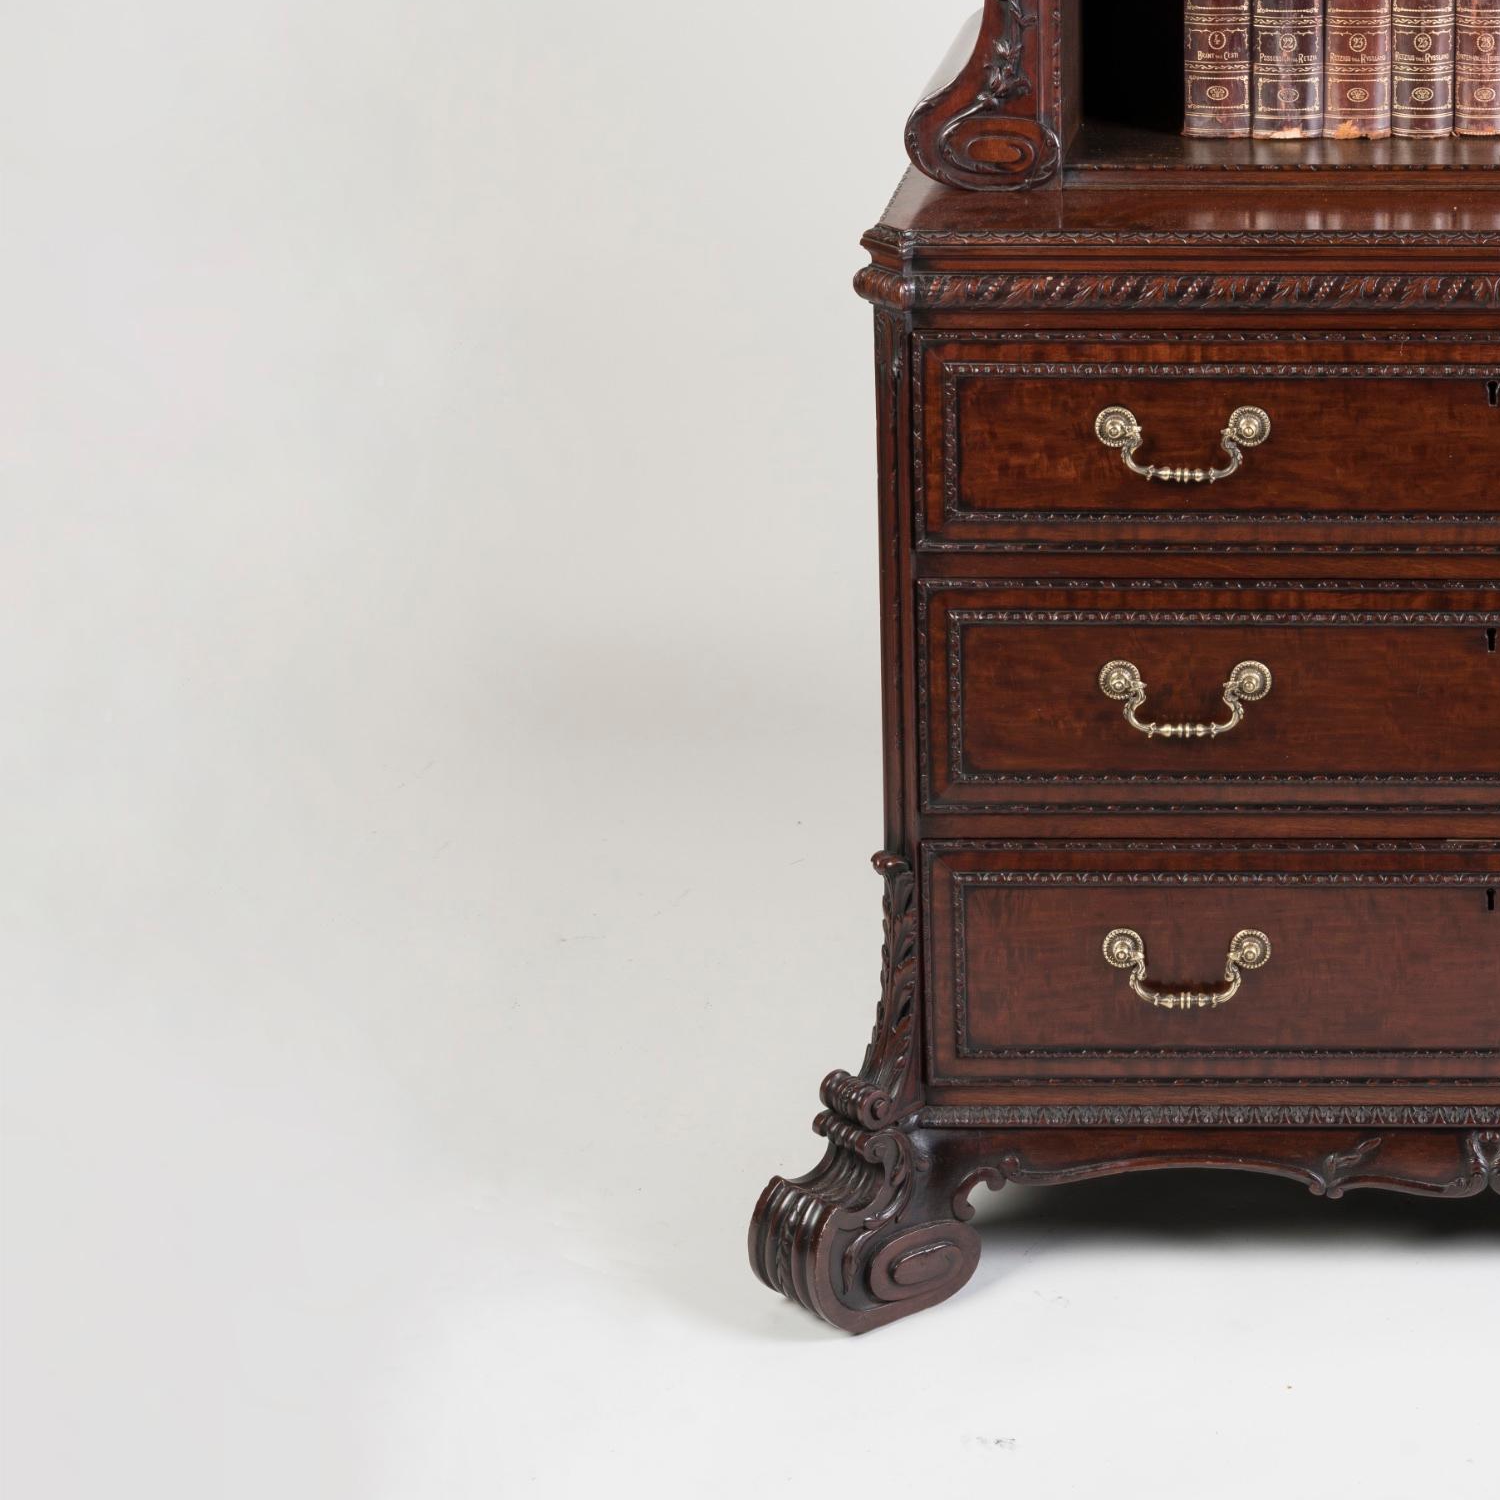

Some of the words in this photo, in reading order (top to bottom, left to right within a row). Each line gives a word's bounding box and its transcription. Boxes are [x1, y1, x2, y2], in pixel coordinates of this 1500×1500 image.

[1282, 37, 1293, 49] 22
[1352, 37, 1364, 49] 23
[1424, 53, 1449, 63] RYSSLAND
